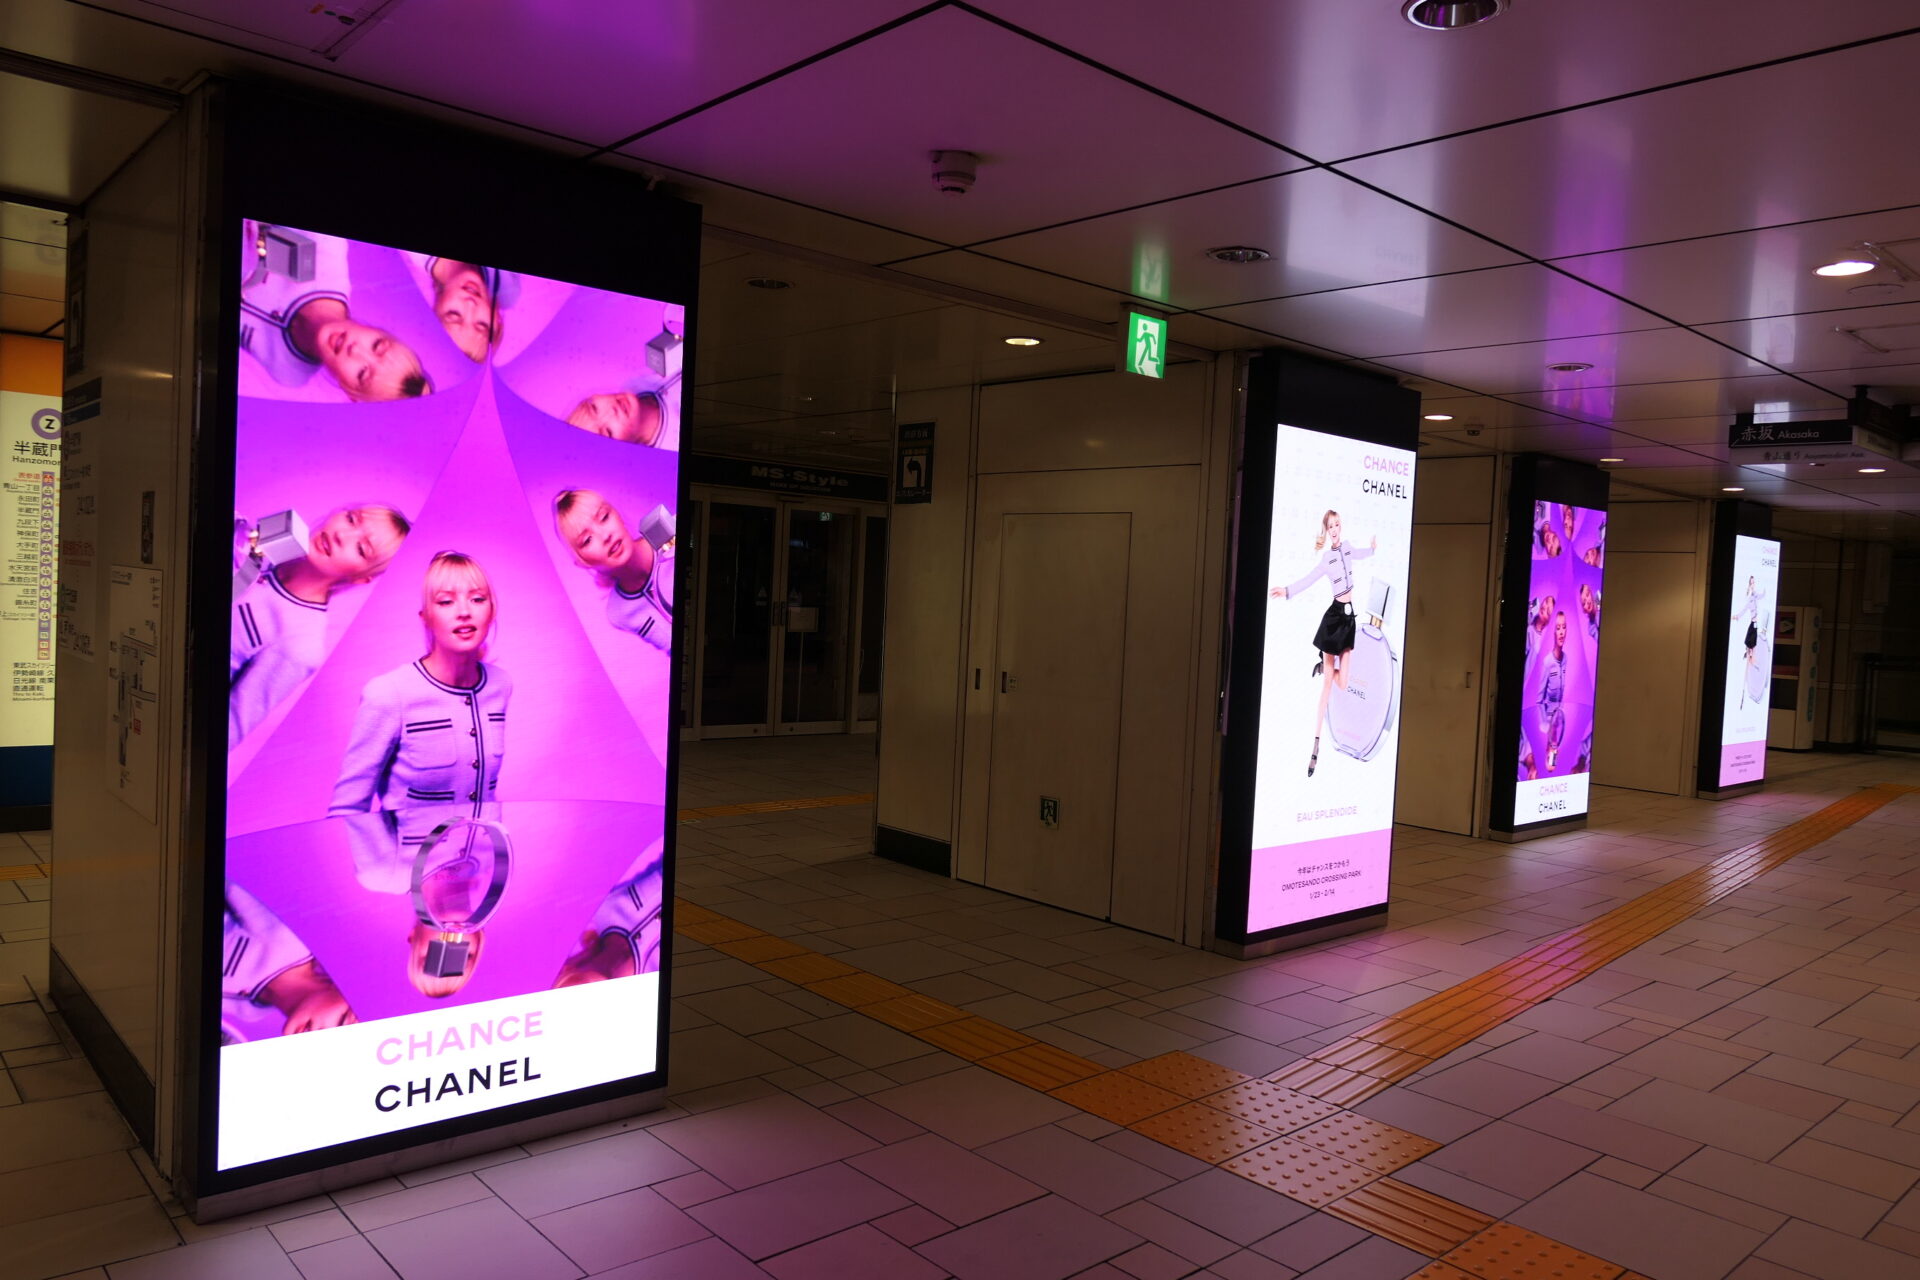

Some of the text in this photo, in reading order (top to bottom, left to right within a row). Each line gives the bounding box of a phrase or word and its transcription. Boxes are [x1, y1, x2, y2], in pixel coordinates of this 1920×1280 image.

[44, 418, 55, 430] Z
[1741, 425, 1820, 441] 赤坂 Akasaka
[1363, 455, 1409, 477] CHANCE
[1362, 479, 1407, 500] CHANEL
[1297, 805, 1358, 823] EAU SPLENDIDE
[1538, 800, 1567, 814] CHANEL
[1281, 870, 1361, 892] OMOTESANDO CROSSING PARK
[376, 1010, 543, 1066] CHANCE
[375, 1056, 542, 1113] CHANEL
